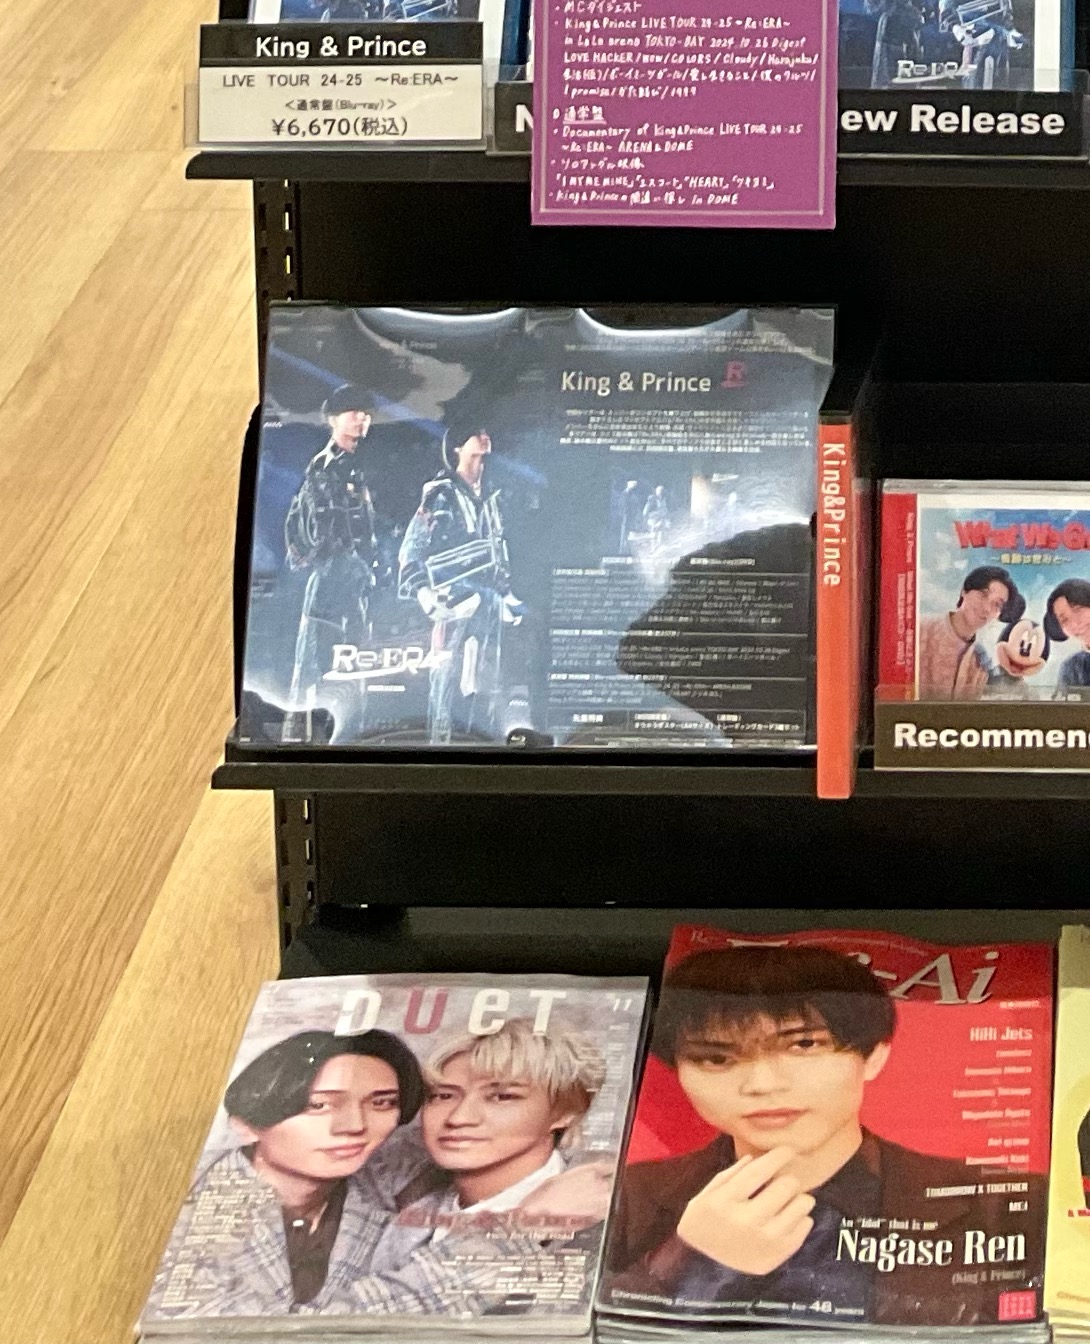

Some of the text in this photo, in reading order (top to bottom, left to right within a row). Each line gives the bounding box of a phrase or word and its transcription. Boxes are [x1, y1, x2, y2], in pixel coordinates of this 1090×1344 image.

[640, 17, 668, 30] LIVE
[255, 35, 427, 58] King & Prince
[563, 52, 590, 63] LOVE
[222, 74, 256, 88] LIVE
[268, 73, 311, 87] TOUR
[320, 73, 363, 87] 24-25
[719, 123, 742, 135] LIVE
[841, 104, 1066, 135] ew Release
[561, 370, 712, 396] King & Prince
[836, 1228, 1026, 1273] Nagase Ren
